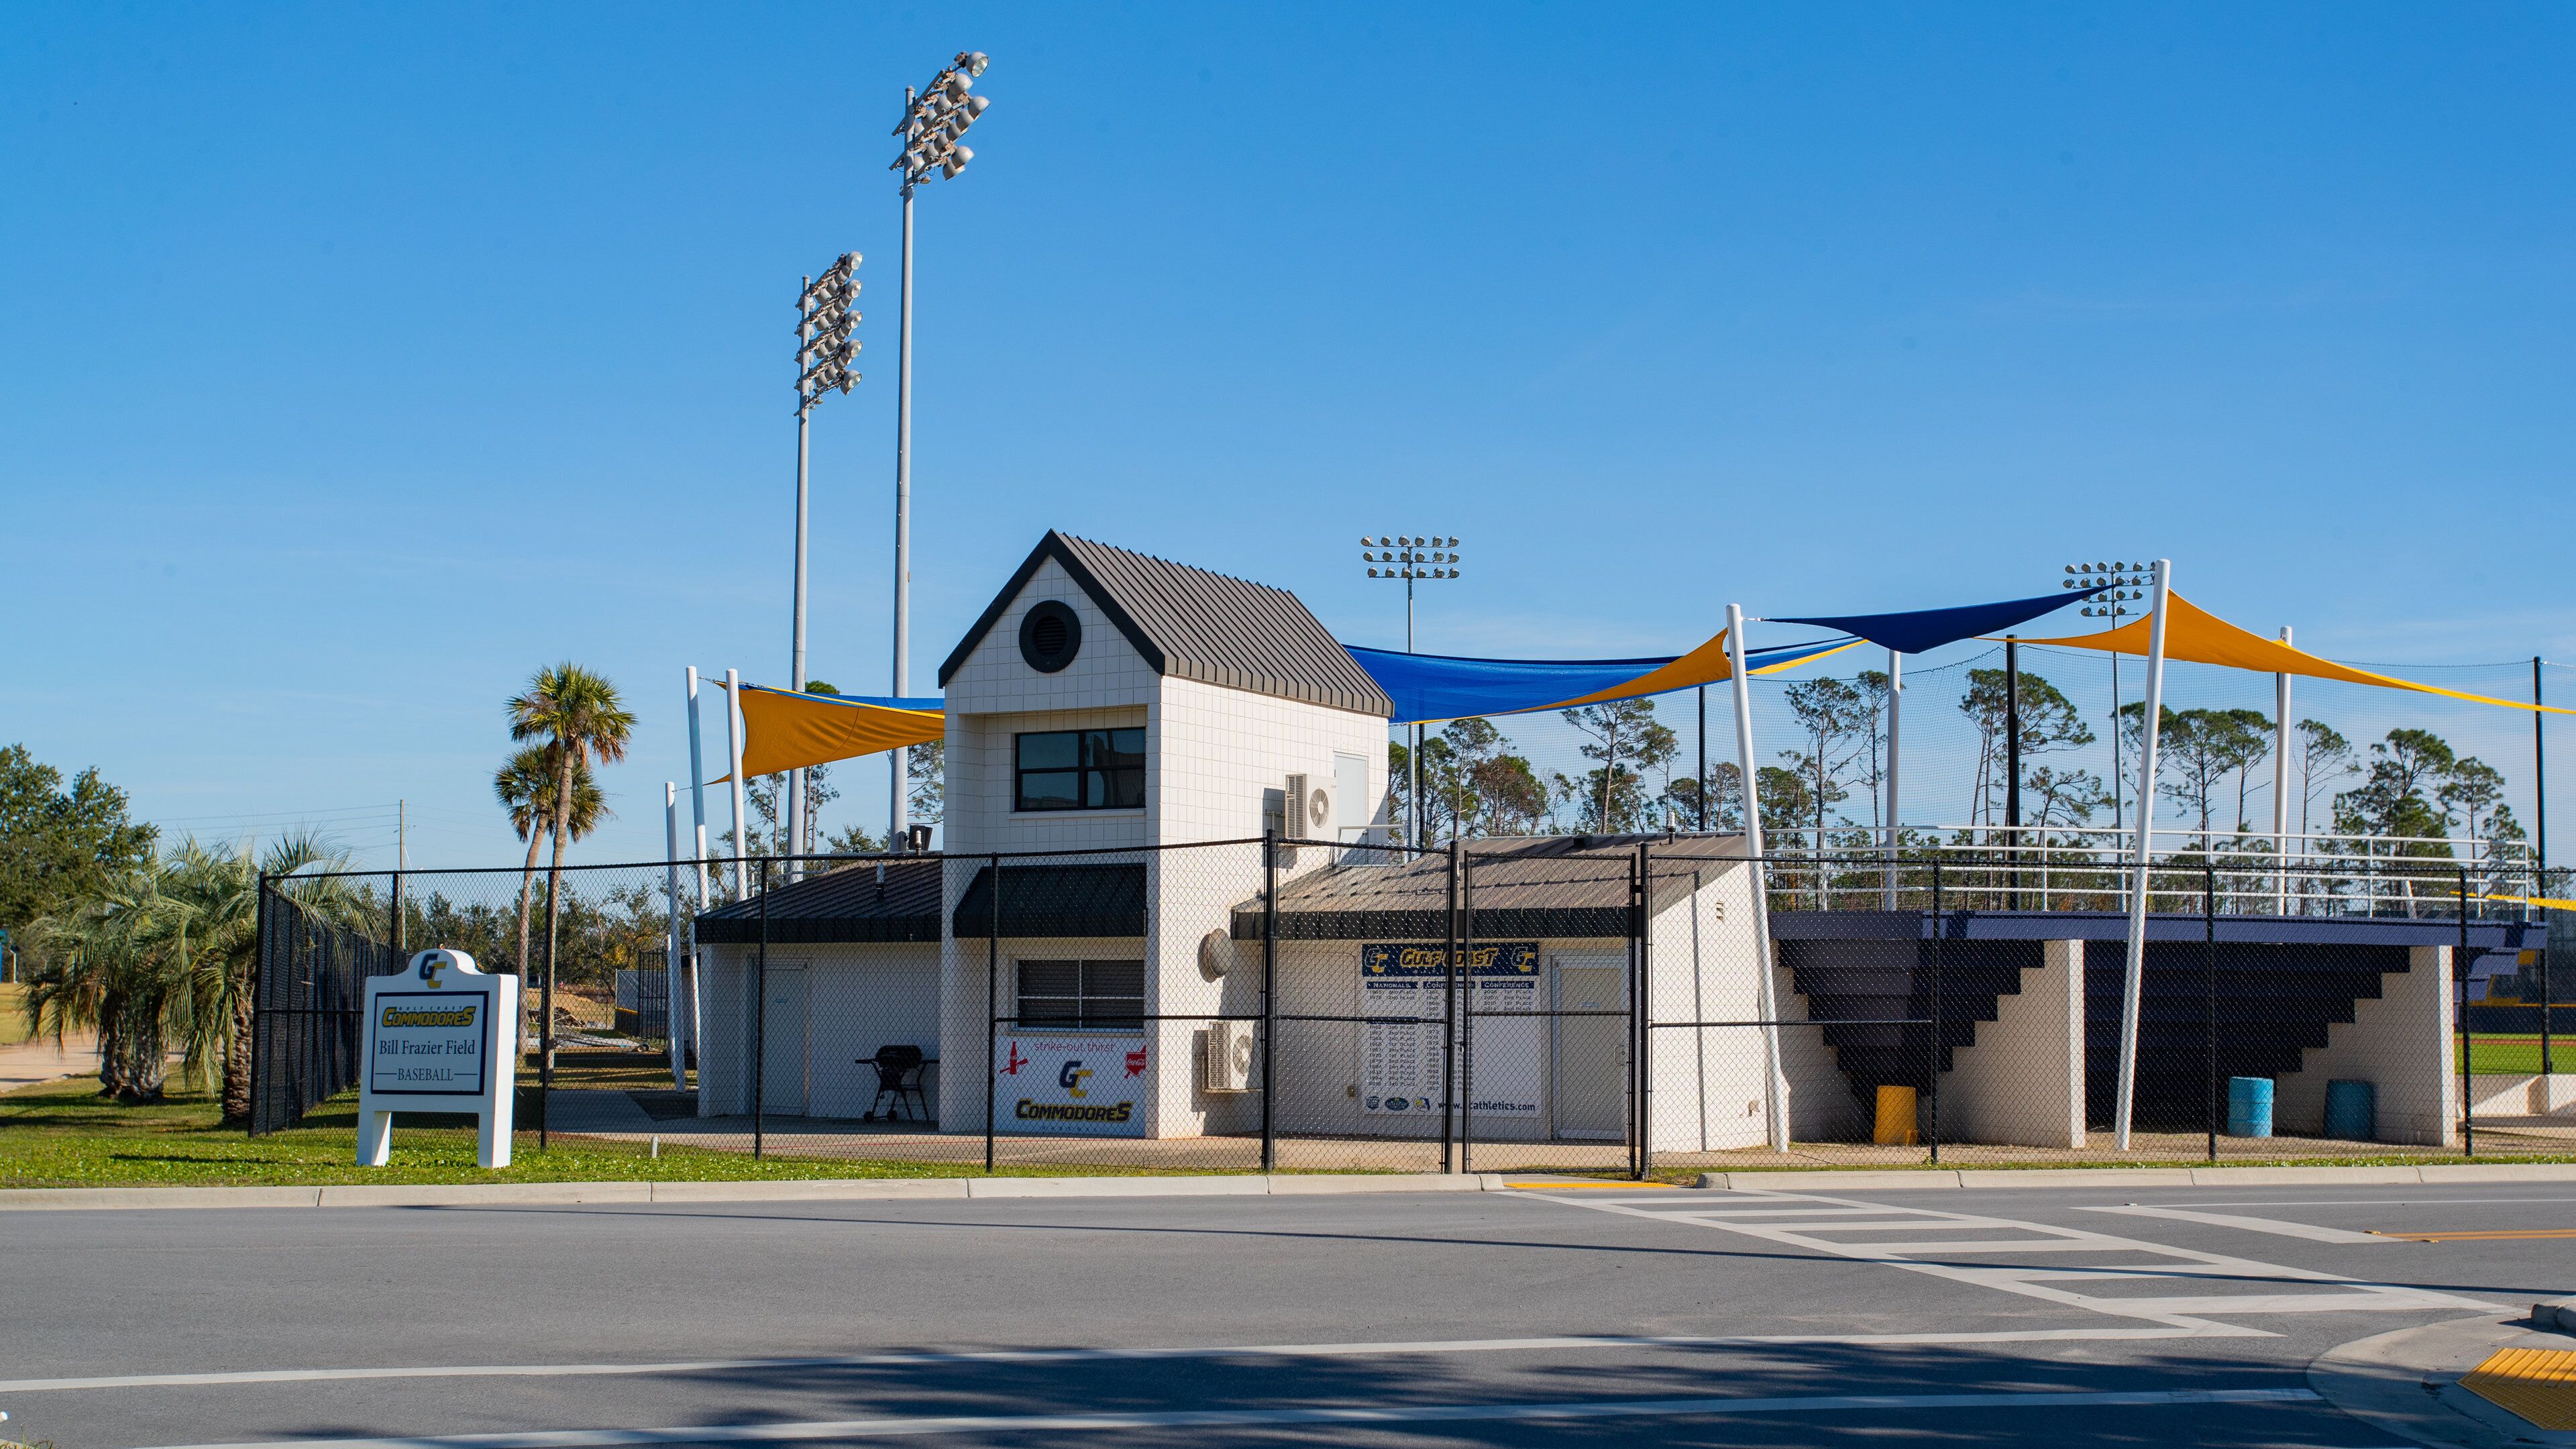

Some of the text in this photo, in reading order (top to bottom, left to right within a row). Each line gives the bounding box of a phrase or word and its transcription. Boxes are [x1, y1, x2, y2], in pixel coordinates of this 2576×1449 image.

[1399, 948, 1499, 967] GULF OAST
[419, 953, 447, 988] GC
[382, 1006, 477, 1027] COMMODORES
[380, 1040, 476, 1054] Bill Frazier Field
[1034, 1041, 1115, 1052] strike-out thirst
[397, 1068, 453, 1081] BASEBALL
[1059, 1060, 1093, 1097] GC
[1015, 1097, 1134, 1124] COMMODORES
[1438, 1101, 1536, 1111] ww.cathletics.com
